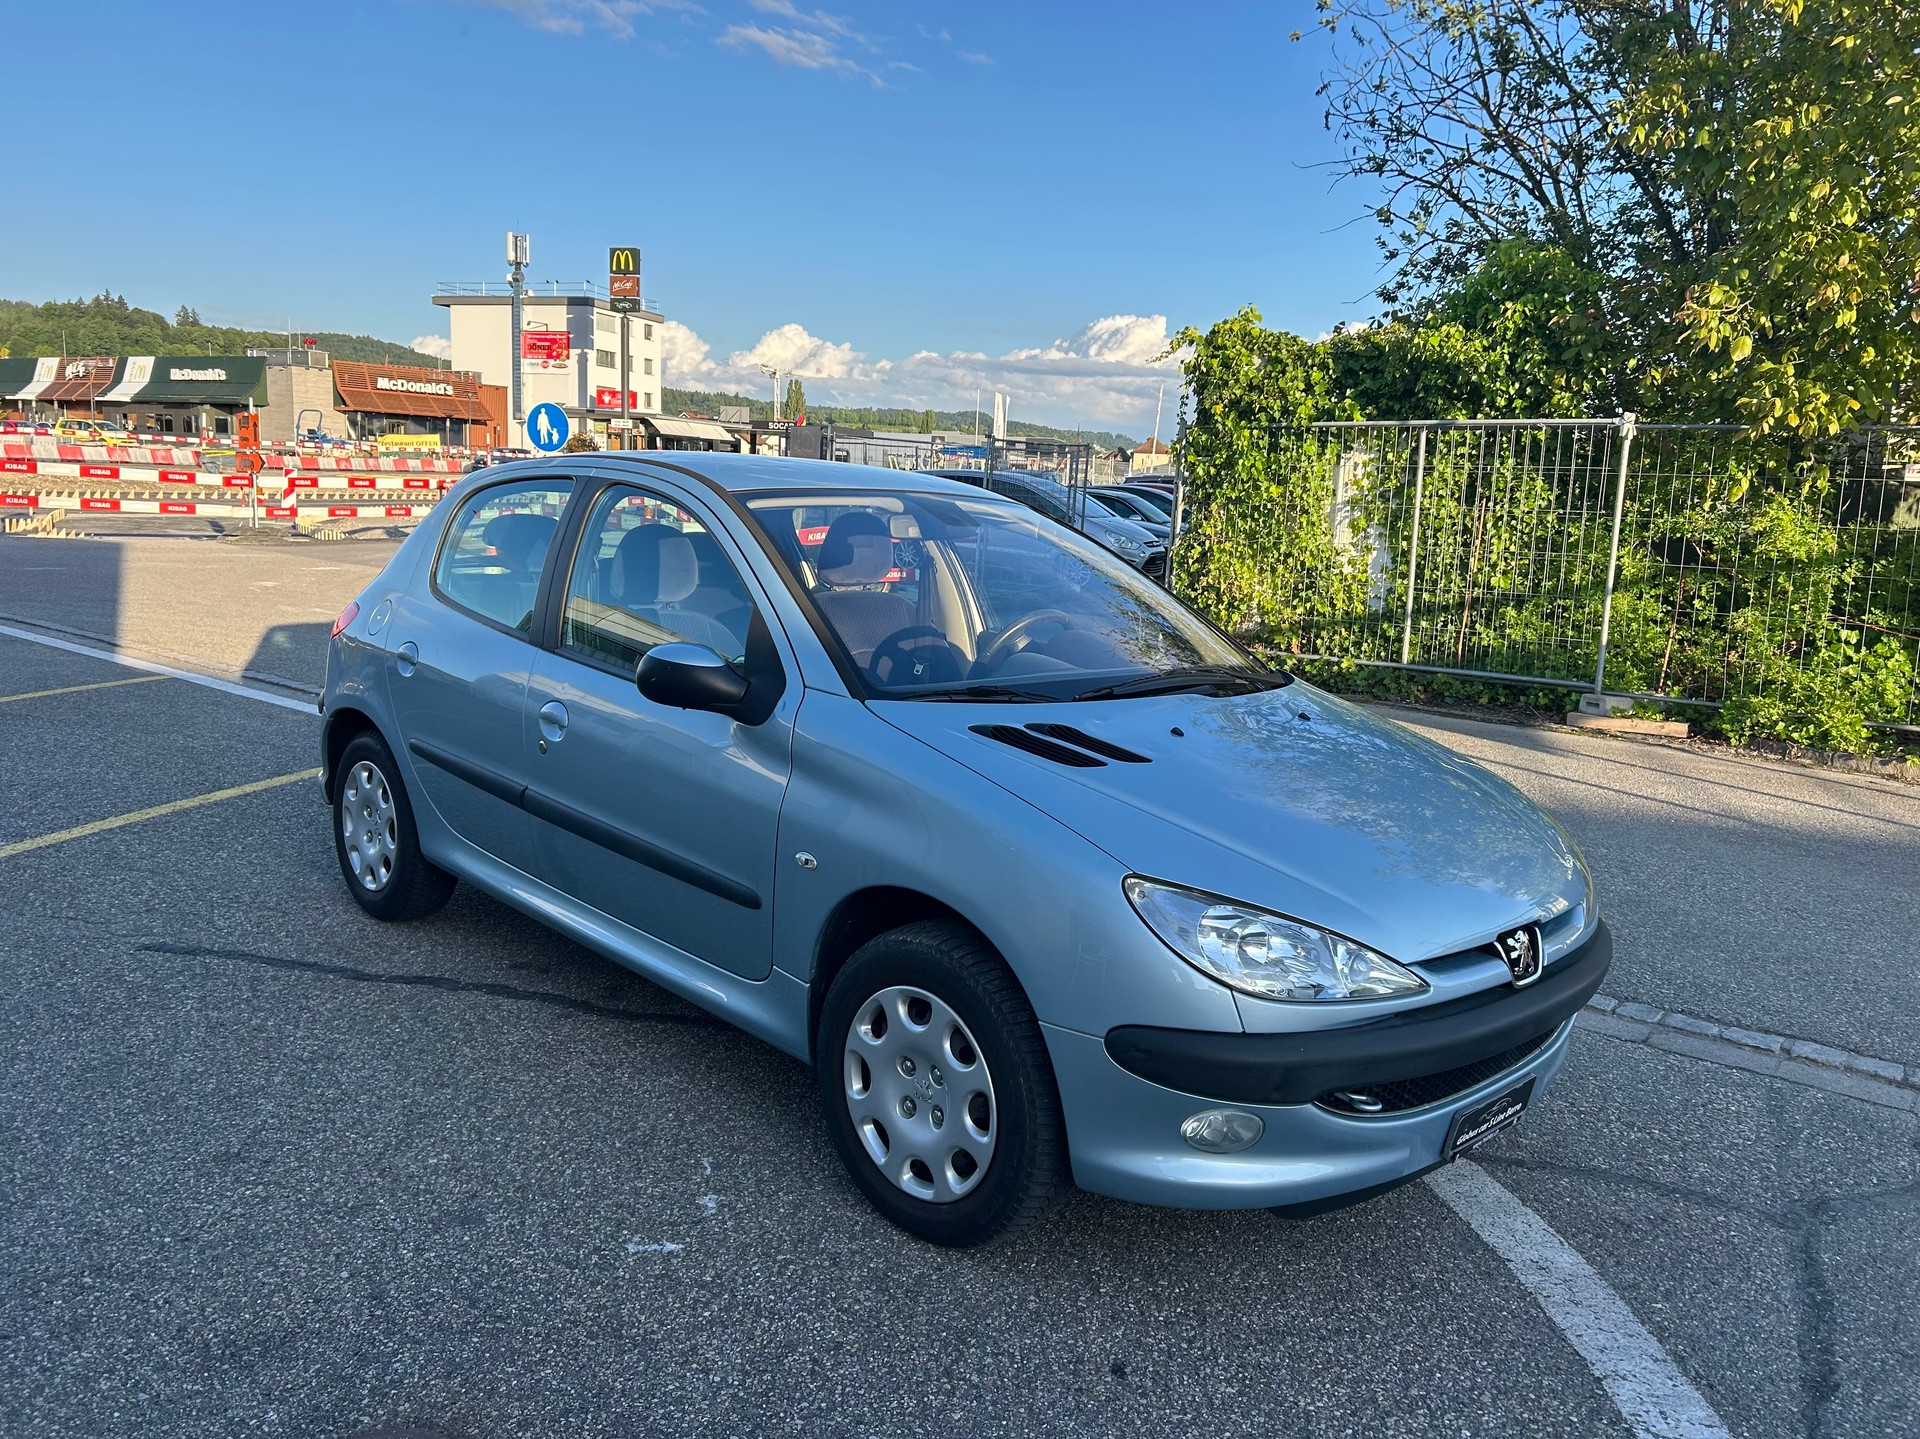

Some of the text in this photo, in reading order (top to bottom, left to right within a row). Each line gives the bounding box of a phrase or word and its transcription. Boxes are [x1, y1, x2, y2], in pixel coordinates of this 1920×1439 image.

[169, 368, 227, 381] McDonald's
[376, 377, 454, 395] McDonald's
[807, 531, 826, 542] KIBA
